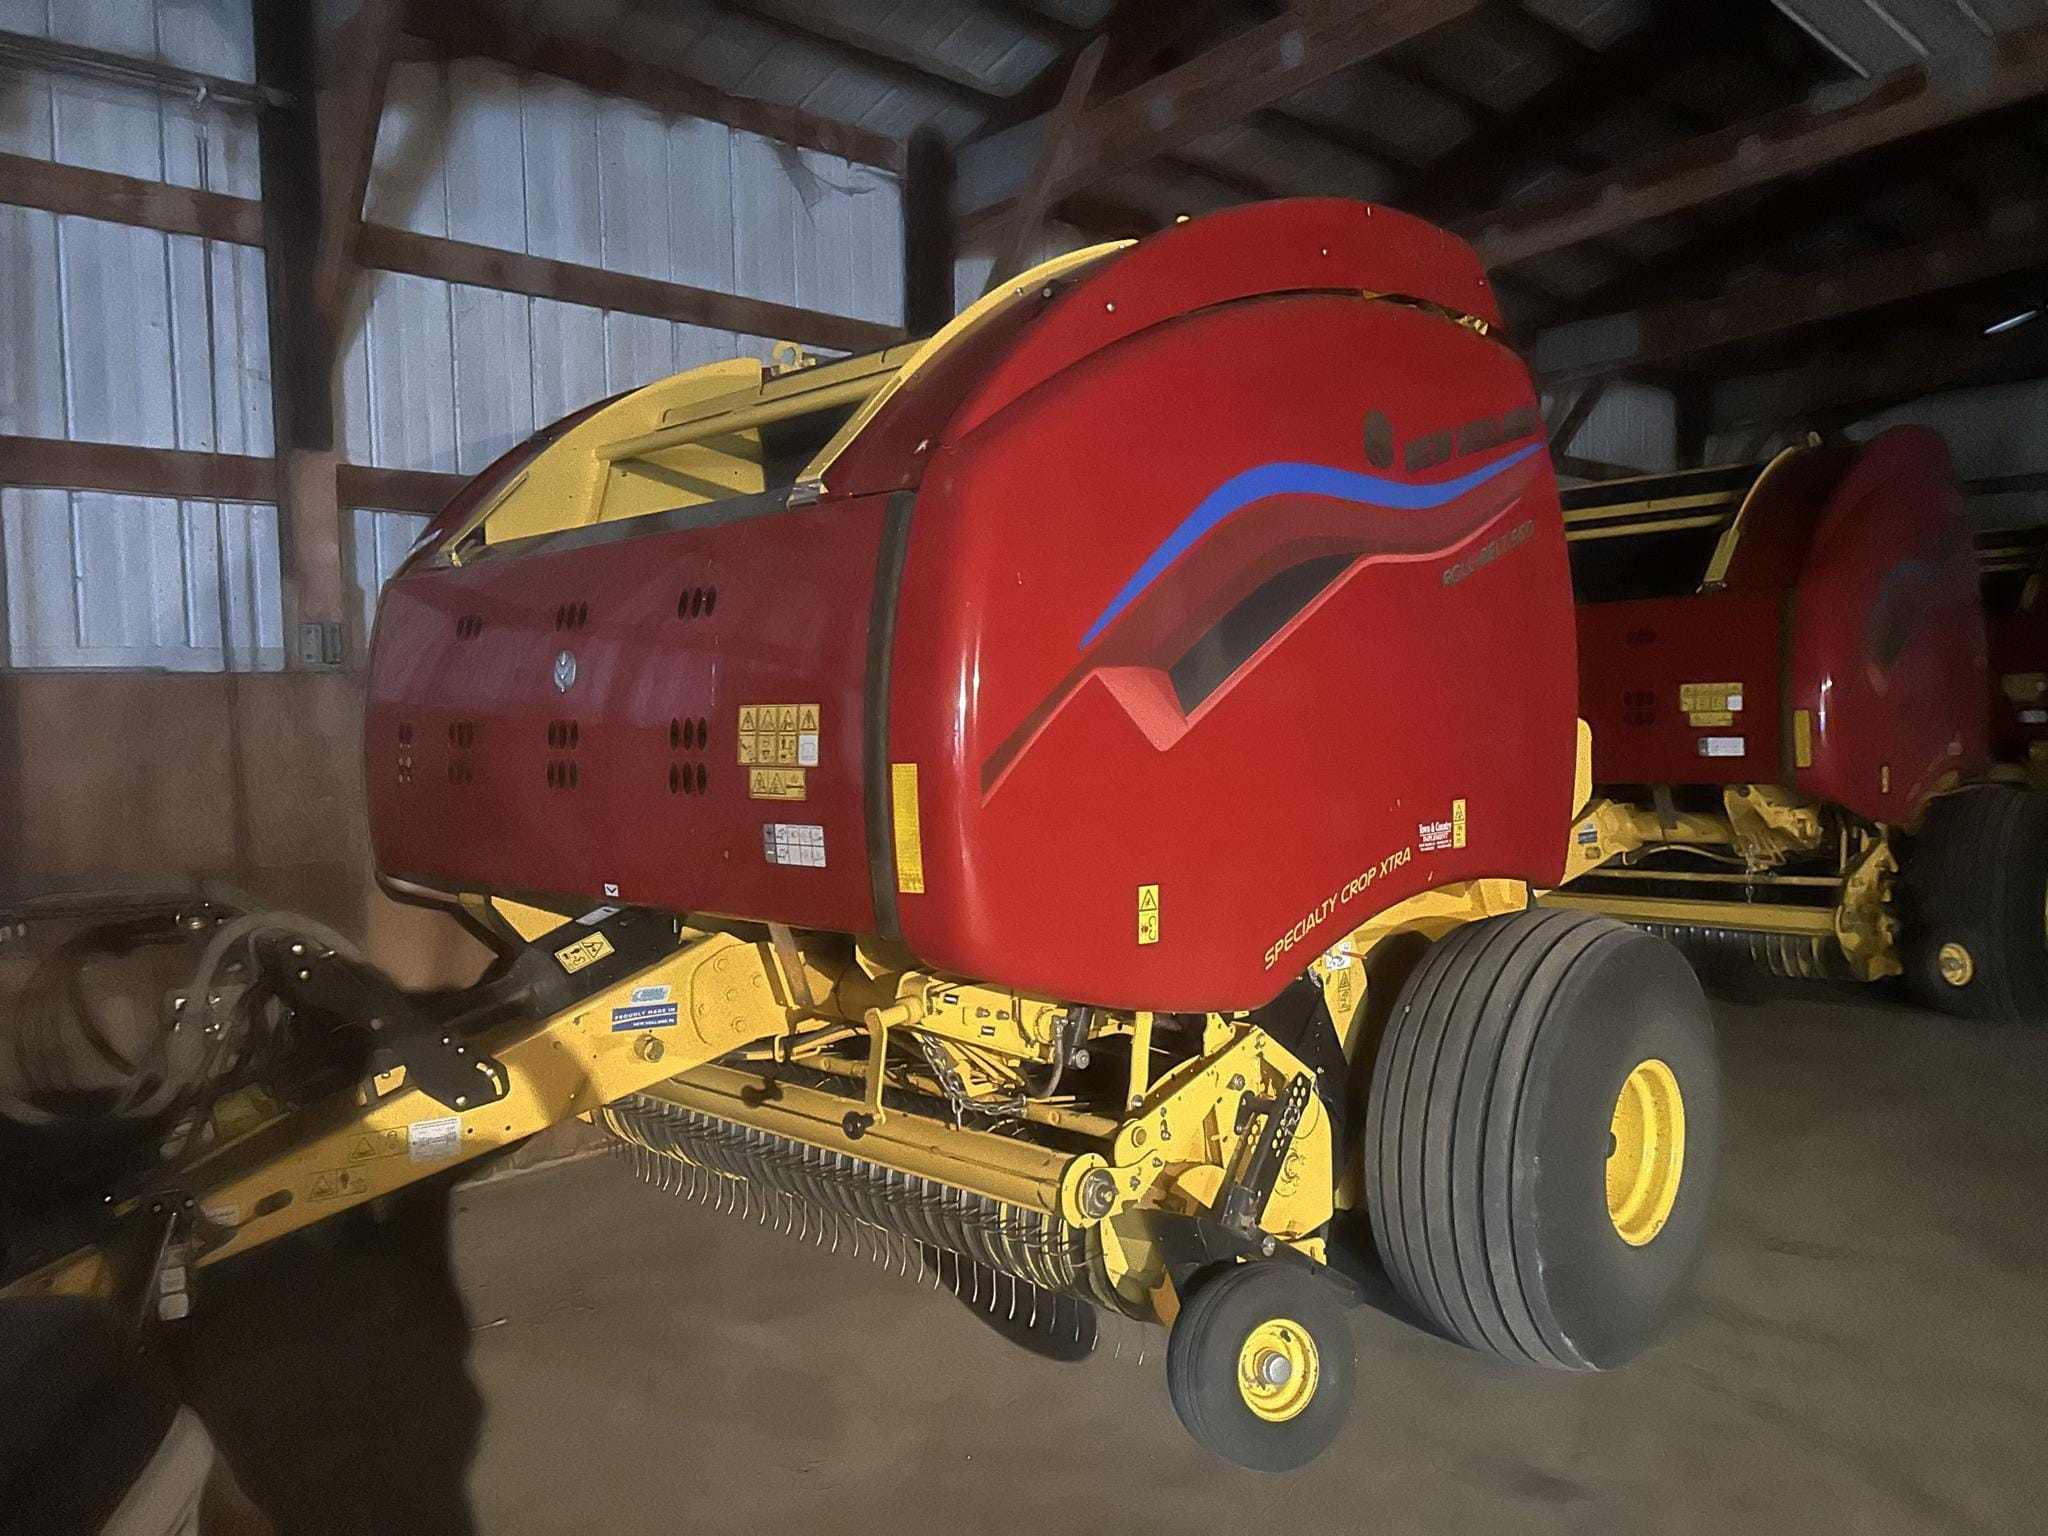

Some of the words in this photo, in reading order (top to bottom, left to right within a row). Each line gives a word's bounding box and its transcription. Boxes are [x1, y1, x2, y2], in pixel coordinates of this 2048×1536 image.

[1264, 893, 1338, 970] SPECIALTY
[1340, 866, 1377, 904] CROP
[1379, 847, 1411, 879] XTRA
[614, 1010, 646, 1021] PROUDLY
